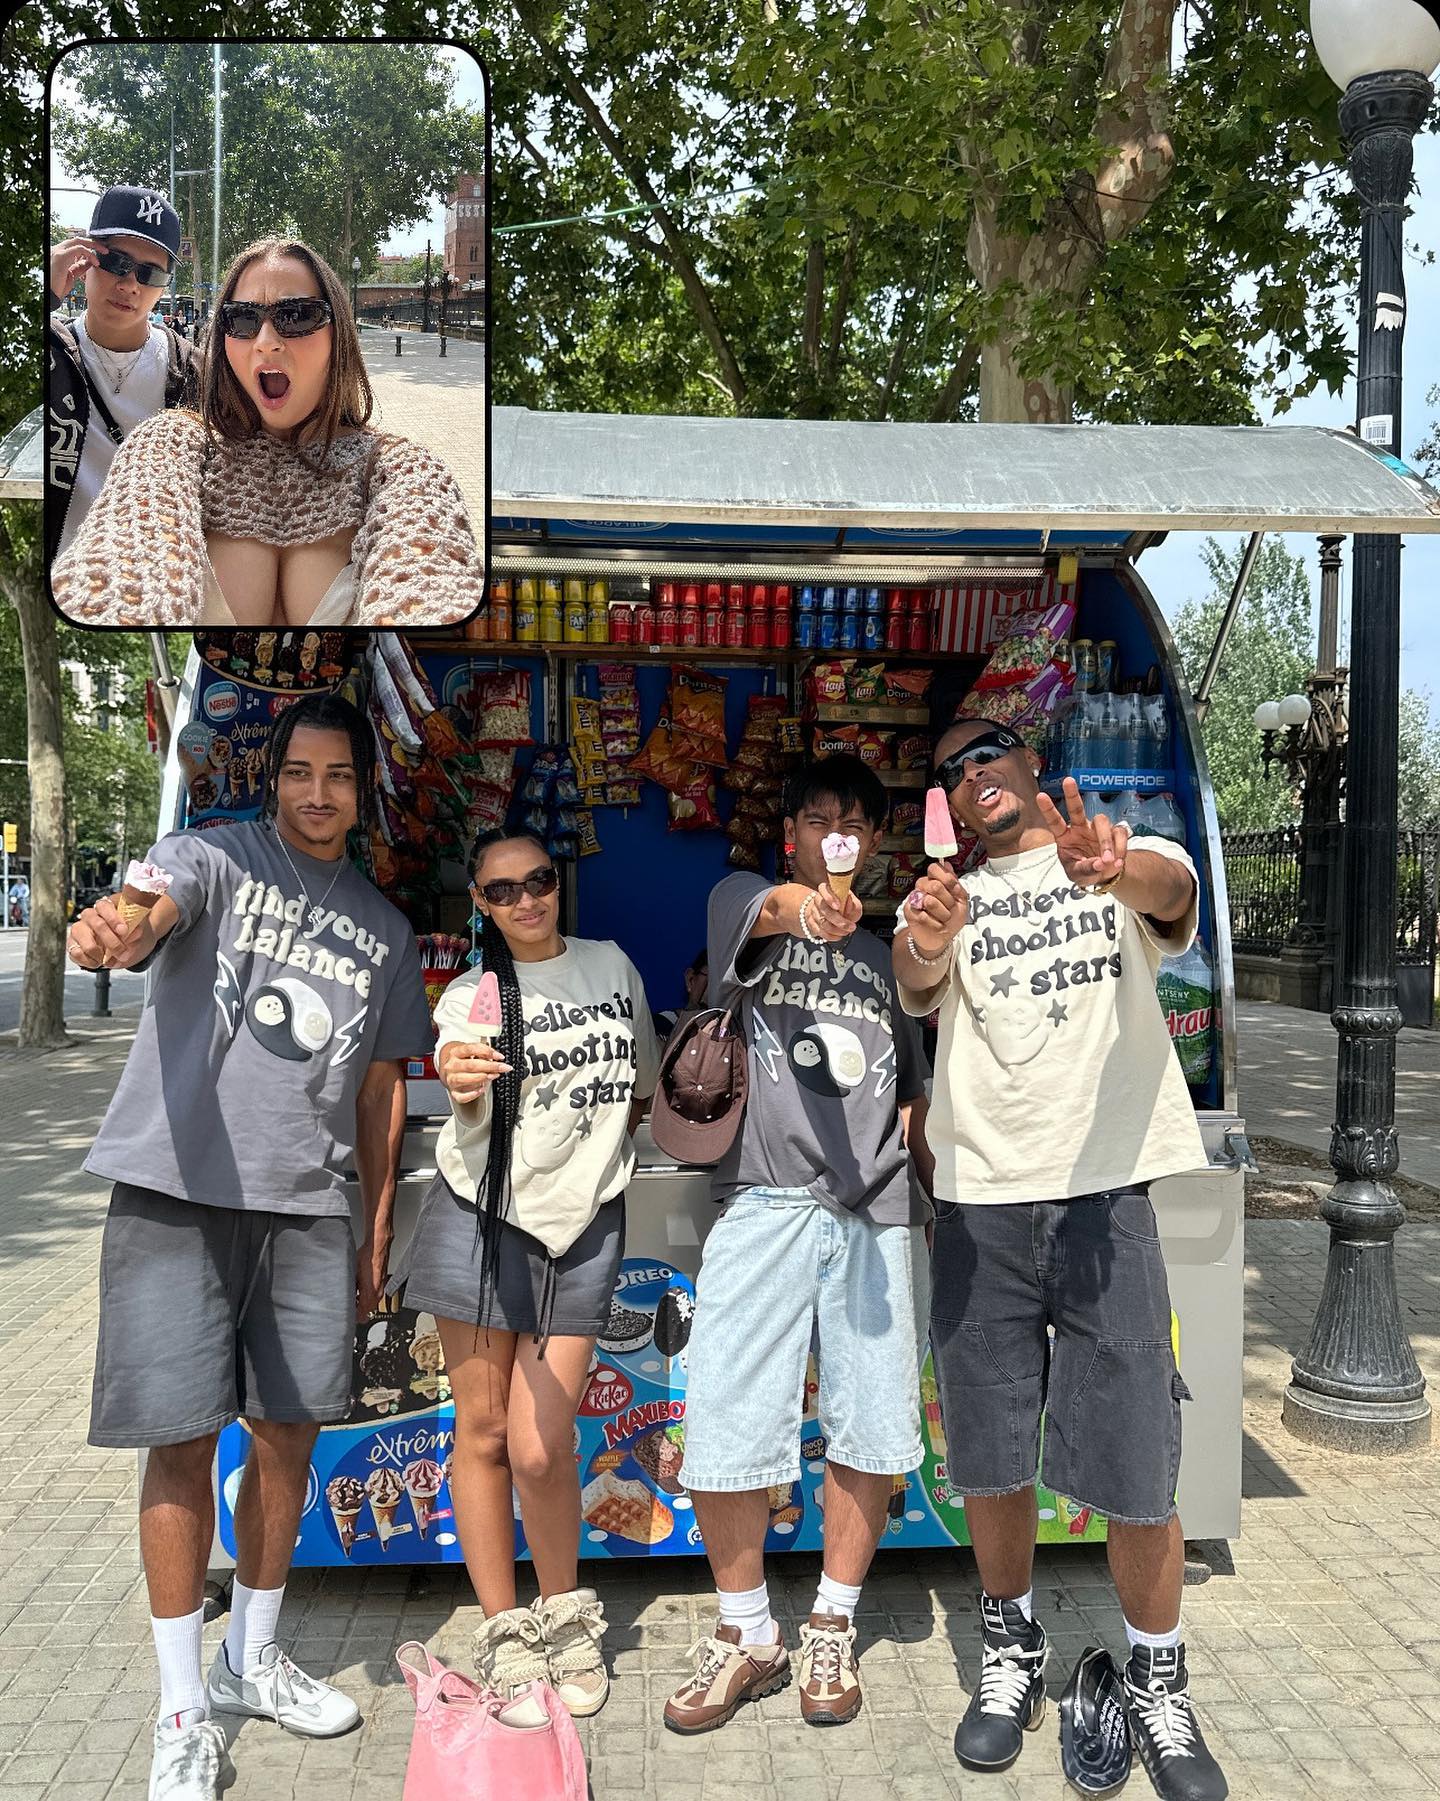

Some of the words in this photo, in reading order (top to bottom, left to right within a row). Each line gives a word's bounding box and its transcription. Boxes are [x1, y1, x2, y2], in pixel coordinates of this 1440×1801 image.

[569, 615, 586, 628] FAN
[887, 689, 911, 698] Dorit
[820, 740, 855, 751] Doritos
[1079, 774, 1167, 787] POWERADE
[895, 805, 922, 819] Ruff
[233, 879, 309, 927] find
[303, 906, 390, 967] your
[970, 903, 1116, 966] shooting
[233, 915, 373, 1000] balance
[767, 938, 828, 974] ind
[1030, 952, 1122, 996] stars
[763, 971, 894, 1035] balance
[1157, 988, 1190, 1000] NTSENY
[1165, 1006, 1212, 1037] drau
[570, 1076, 635, 1109] star
[594, 1386, 626, 1409] KitKat
[602, 1400, 687, 1450] MAXIBO
[366, 1428, 455, 1467] extrêm
[801, 1438, 824, 1452] choco
